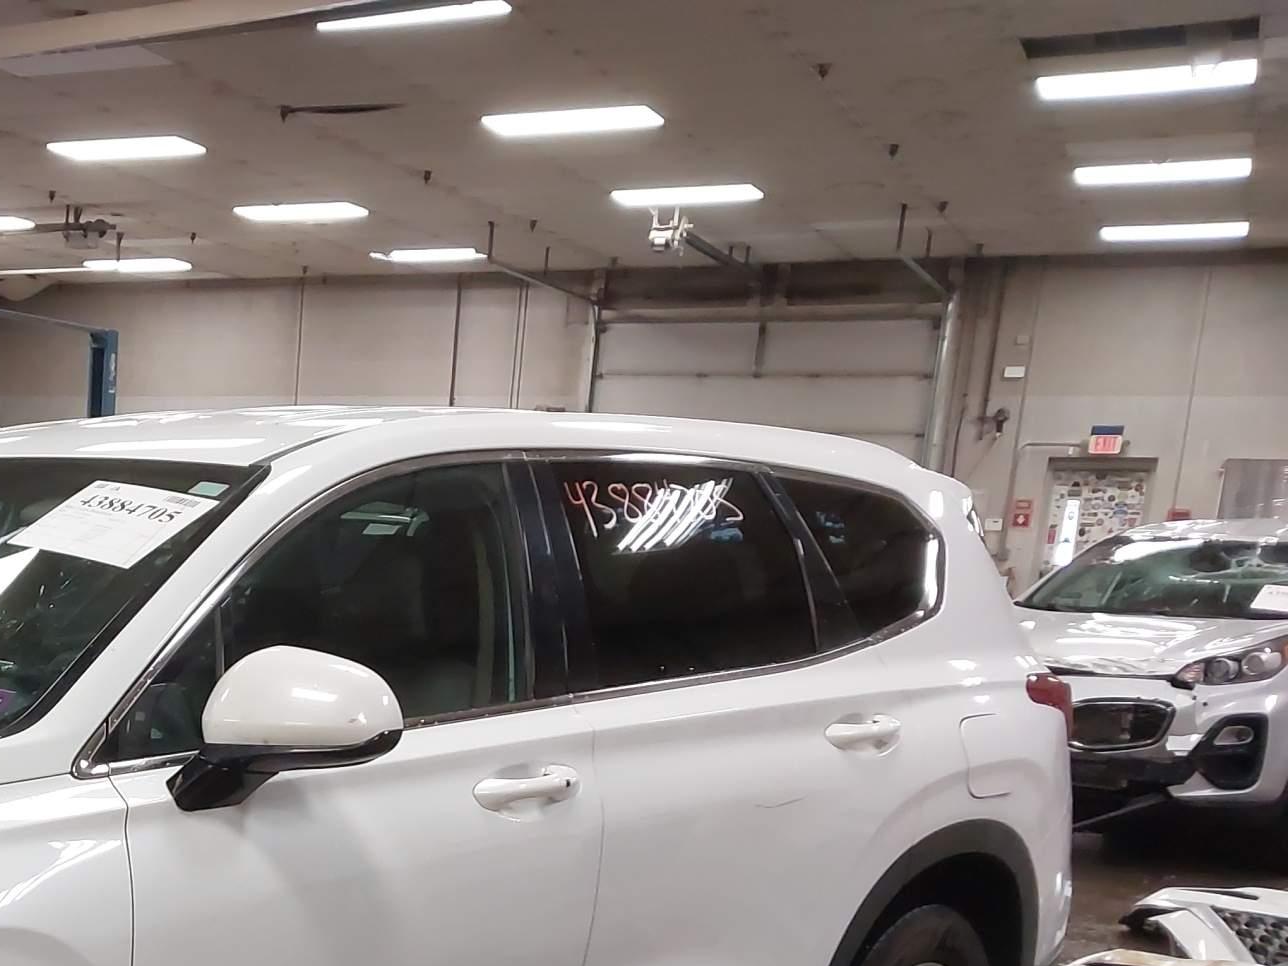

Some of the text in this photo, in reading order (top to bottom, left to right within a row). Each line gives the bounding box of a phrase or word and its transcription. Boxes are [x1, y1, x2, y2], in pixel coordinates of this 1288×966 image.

[1094, 436, 1118, 451] EXIT
[79, 494, 183, 523] 43884705
[564, 479, 744, 539] 43885
